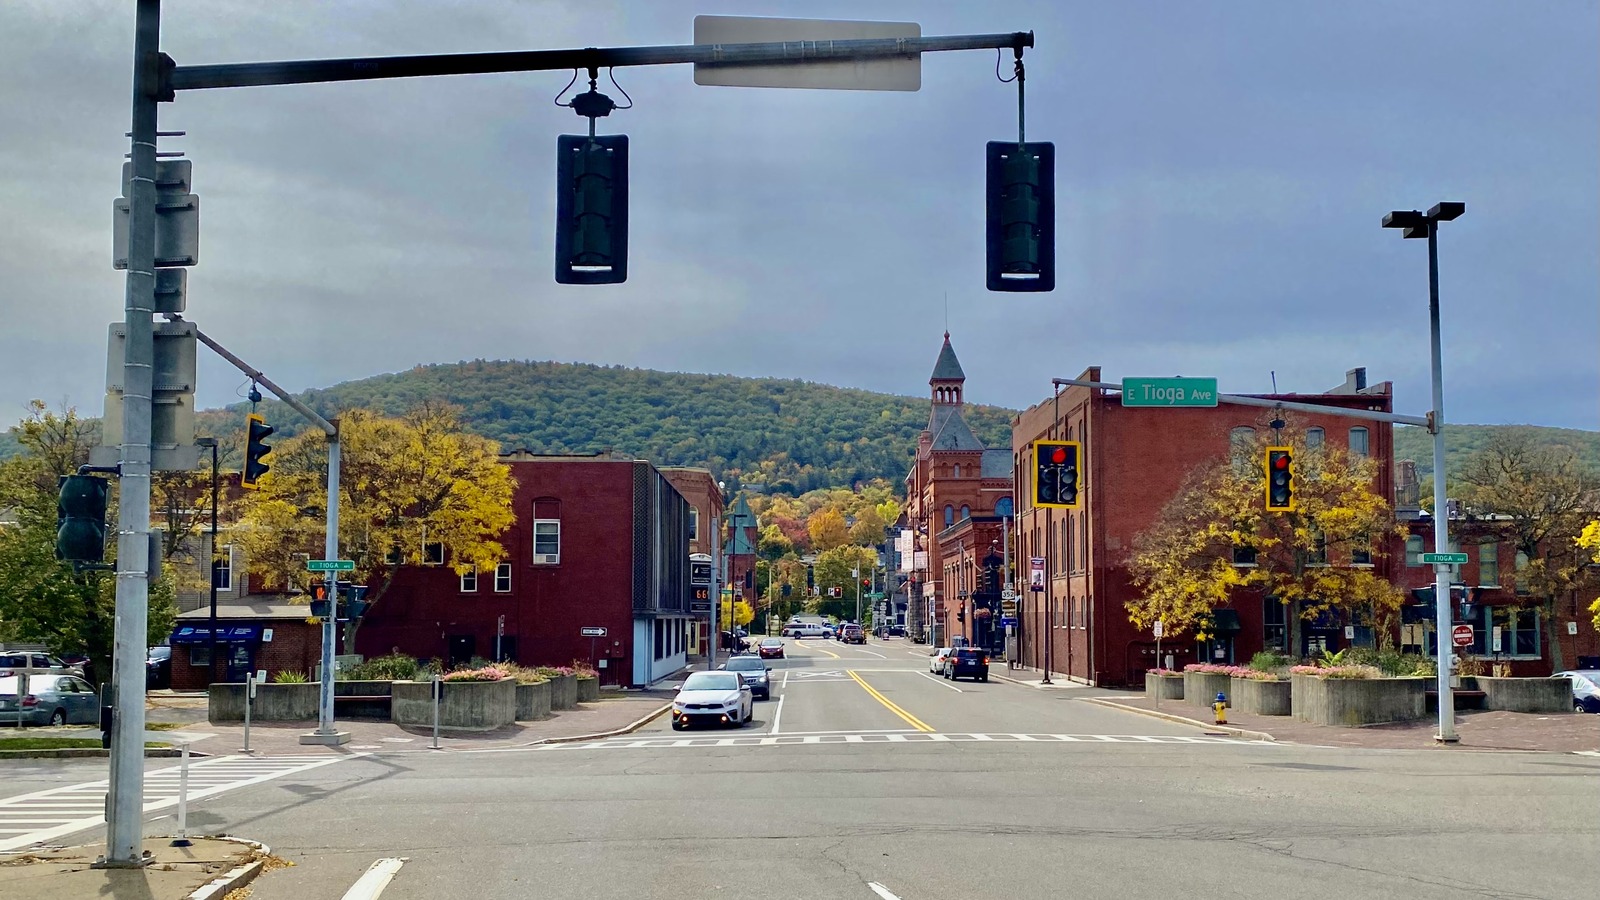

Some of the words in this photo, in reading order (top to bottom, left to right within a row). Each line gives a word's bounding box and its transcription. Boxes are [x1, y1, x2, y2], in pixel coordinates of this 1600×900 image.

[1127, 388, 1135, 400] E
[1141, 384, 1185, 405] Tioga
[1191, 389, 1211, 400] Ave
